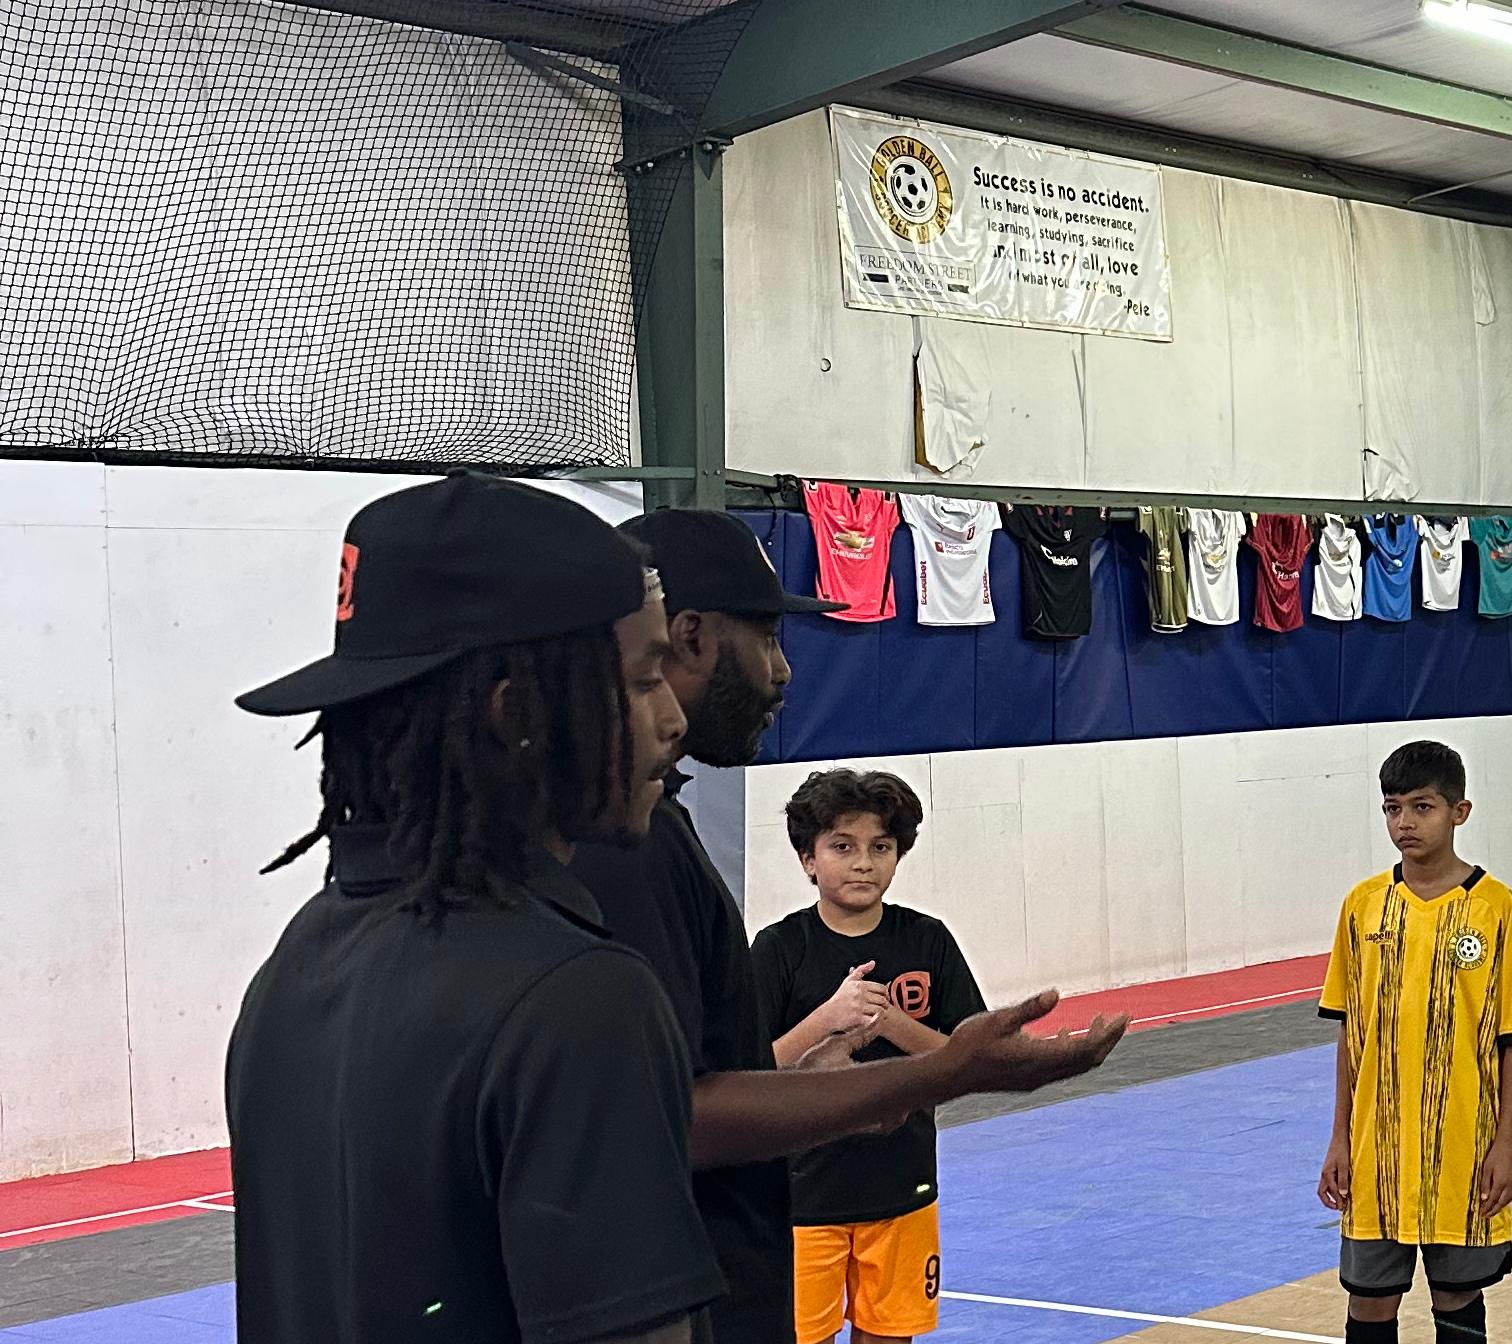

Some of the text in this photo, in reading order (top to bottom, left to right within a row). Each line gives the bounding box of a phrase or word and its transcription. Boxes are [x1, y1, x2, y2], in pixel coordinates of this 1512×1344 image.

[973, 166, 1150, 213] Success is no accident.
[980, 195, 990, 209] It
[1005, 199, 1030, 216] hard
[1033, 206, 1063, 223] work,
[1065, 211, 1137, 234] perseverance,
[1039, 229, 1089, 248] studying,
[1091, 234, 1135, 252] sacrifice
[860, 254, 973, 281] FREEDOM STREET
[1082, 253, 1105, 275] all,
[1107, 256, 1139, 276] love
[895, 274, 945, 291] PARTERS
[1022, 272, 1049, 287] what
[1093, 280, 1127, 297] ding.
[924, 1254, 941, 1301] 9
